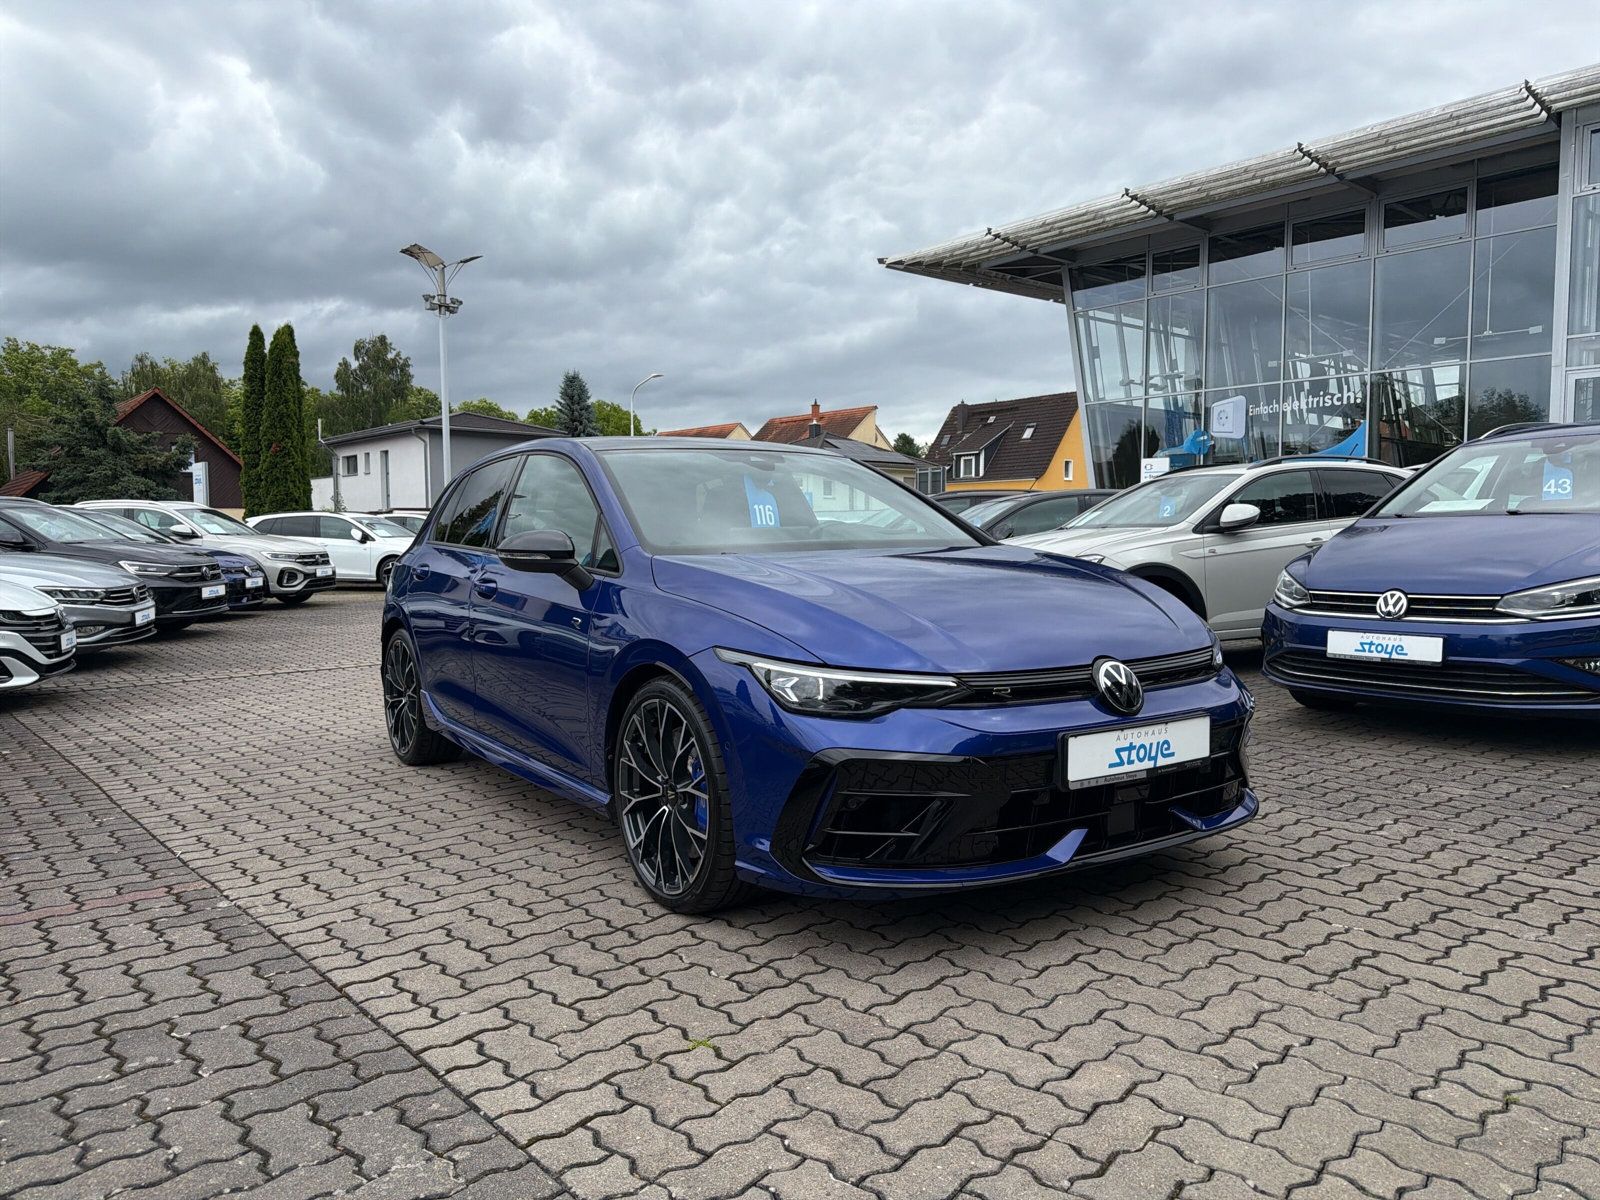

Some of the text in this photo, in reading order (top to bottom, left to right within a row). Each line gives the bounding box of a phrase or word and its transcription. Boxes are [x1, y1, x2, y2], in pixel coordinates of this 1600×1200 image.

[1248, 399, 1279, 416] Einfach
[1543, 478, 1571, 495] 43
[753, 503, 775, 526] 116
[1163, 505, 1171, 517] 2
[1360, 634, 1403, 642] AUTOHAUS
[1115, 727, 1169, 742] AUTOHAUS
